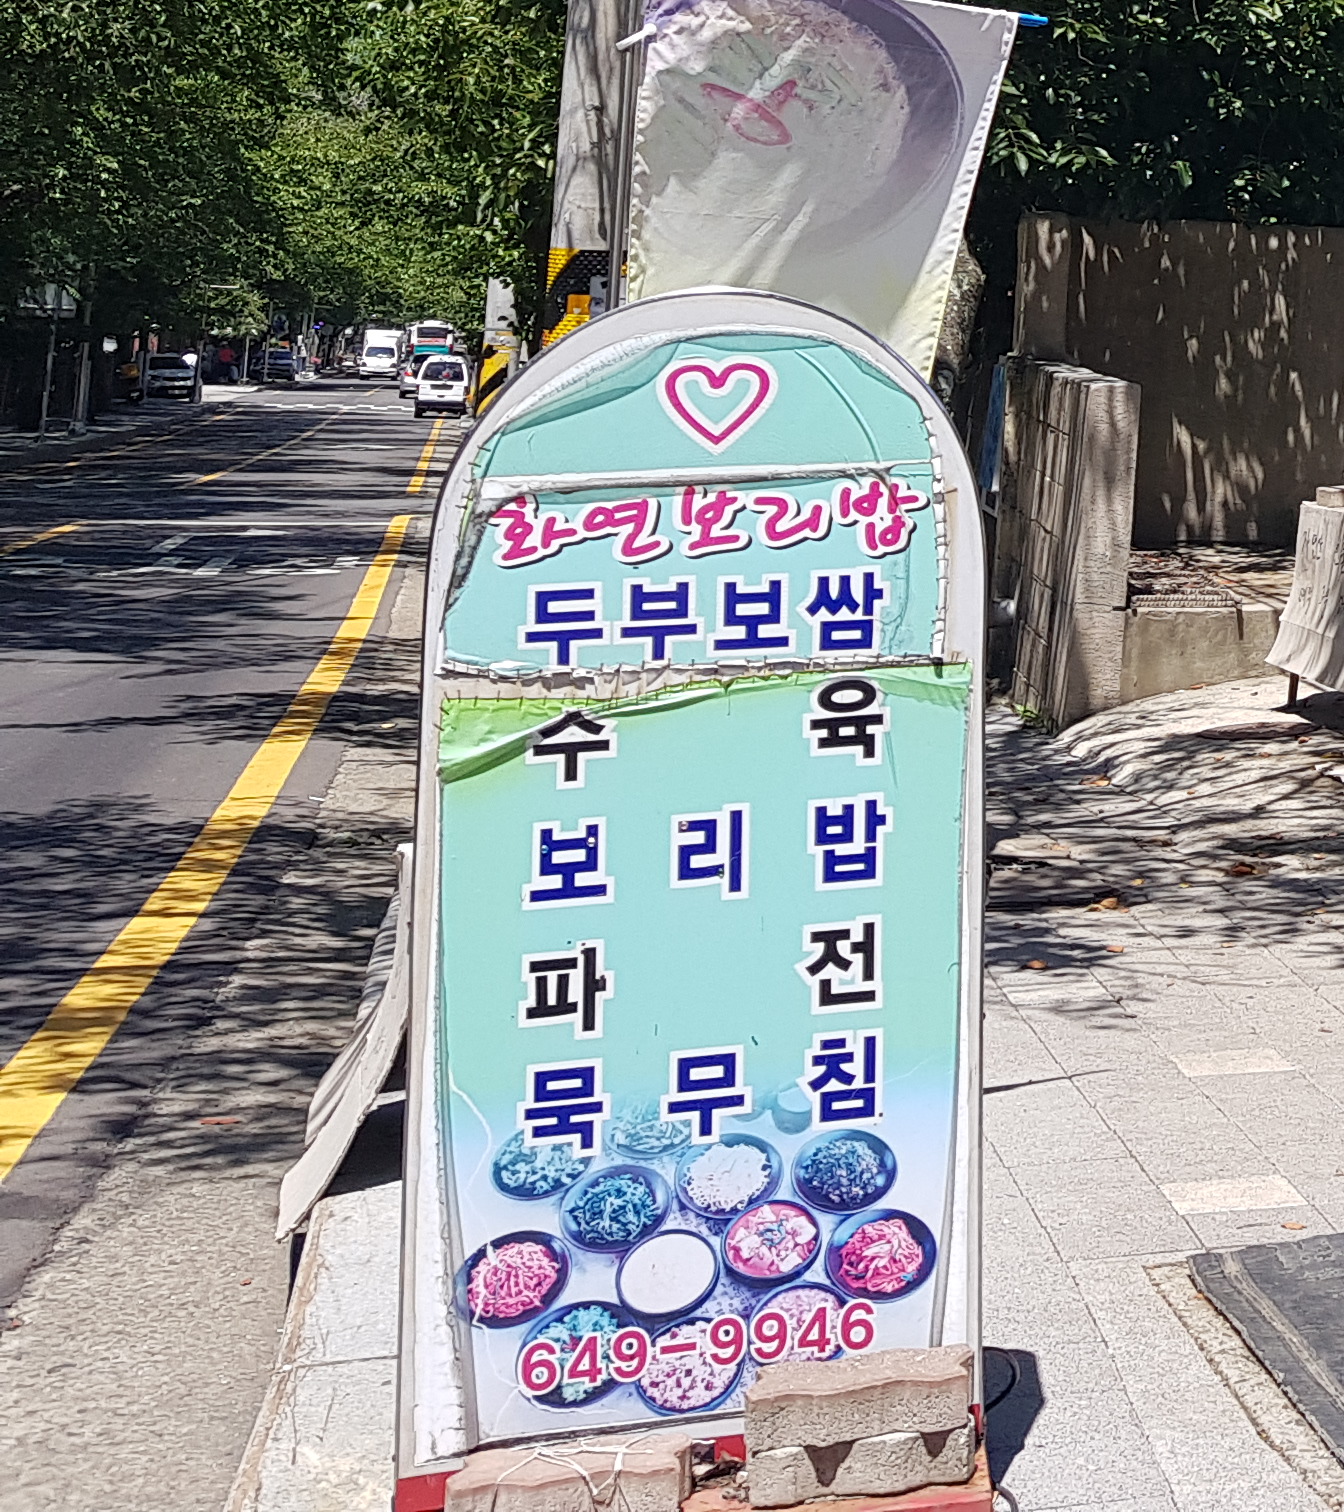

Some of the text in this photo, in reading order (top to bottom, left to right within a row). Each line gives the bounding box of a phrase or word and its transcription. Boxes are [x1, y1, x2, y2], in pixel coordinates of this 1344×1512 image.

[494, 481, 929, 563] 화연보리밥
[524, 570, 884, 666] 두부보쌈
[521, 1301, 876, 1394] 649-9946
